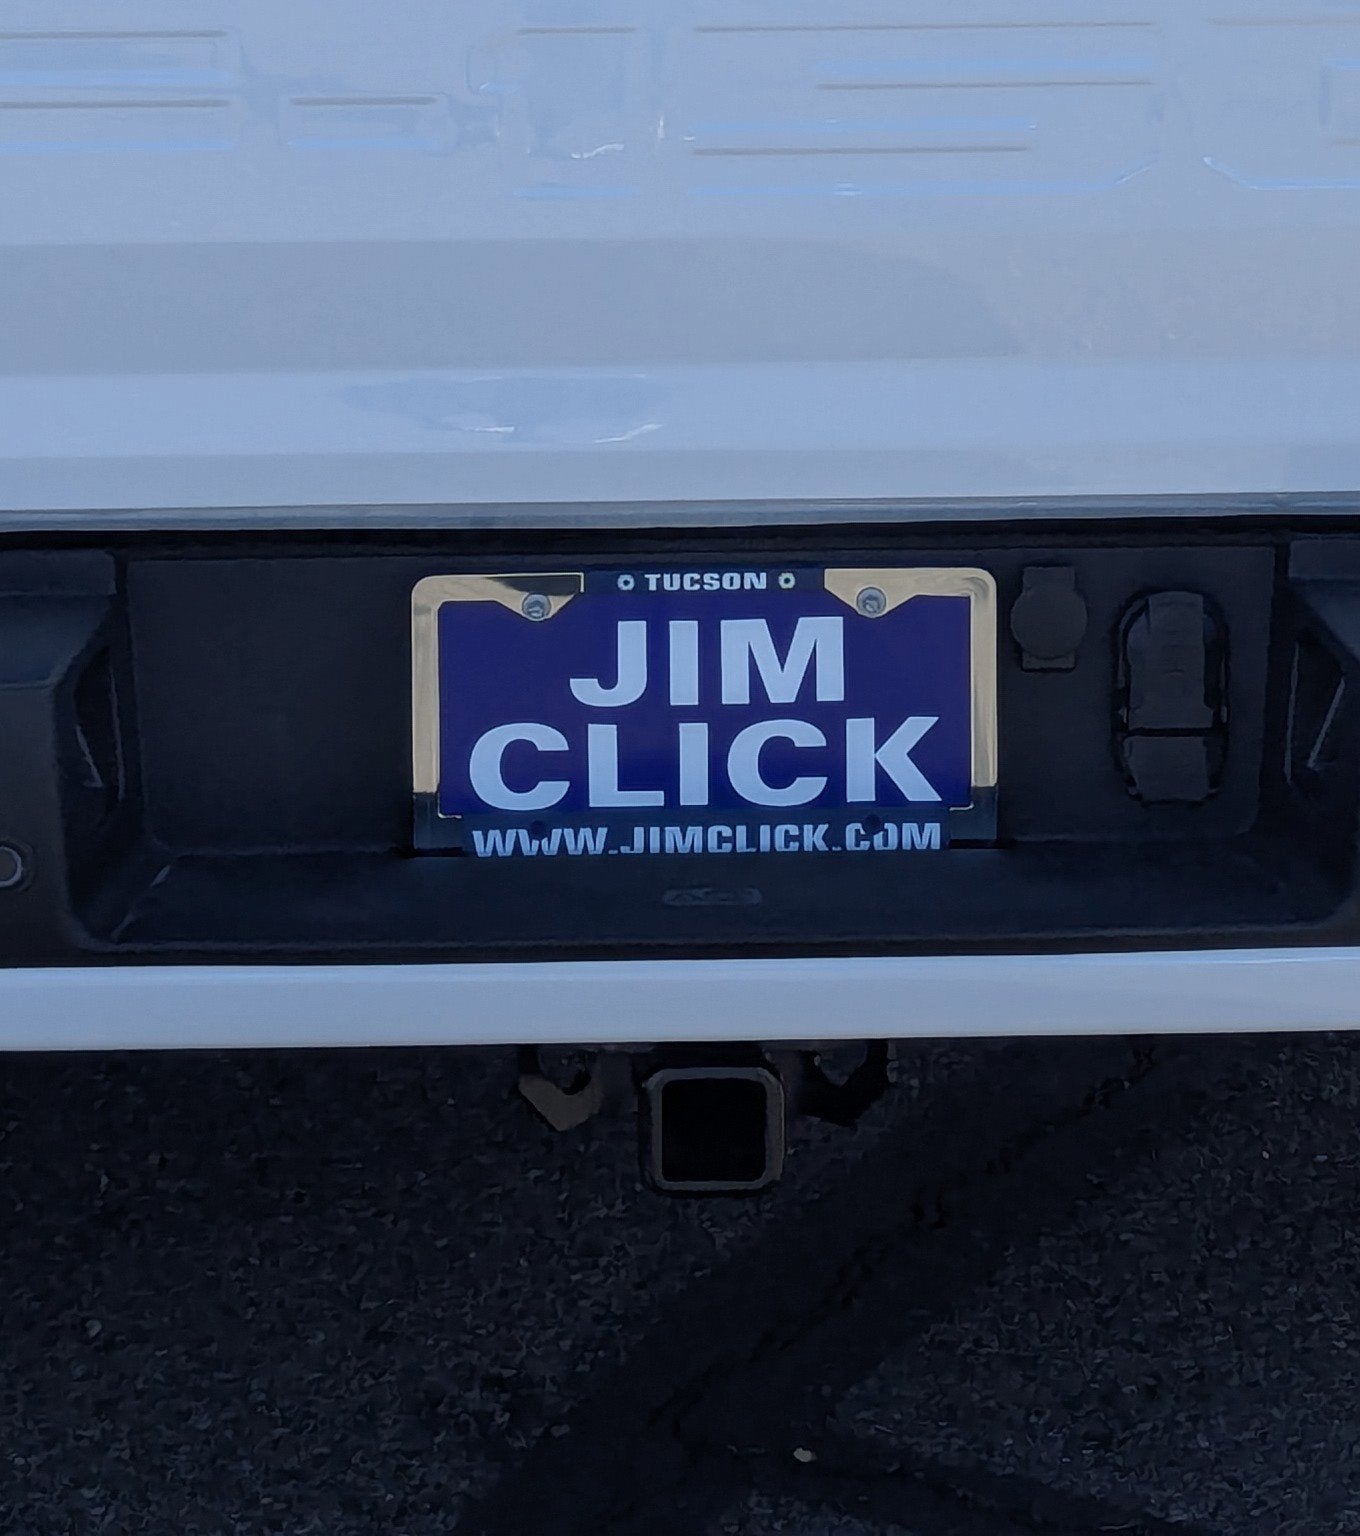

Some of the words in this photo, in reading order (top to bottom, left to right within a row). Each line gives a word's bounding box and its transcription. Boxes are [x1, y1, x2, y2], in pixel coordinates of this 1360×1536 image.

[645, 571, 768, 591] TUCSON
[569, 616, 845, 708] JIM
[469, 716, 942, 811] CLICK
[472, 822, 941, 858] WWW.JIMCLICK.COM
